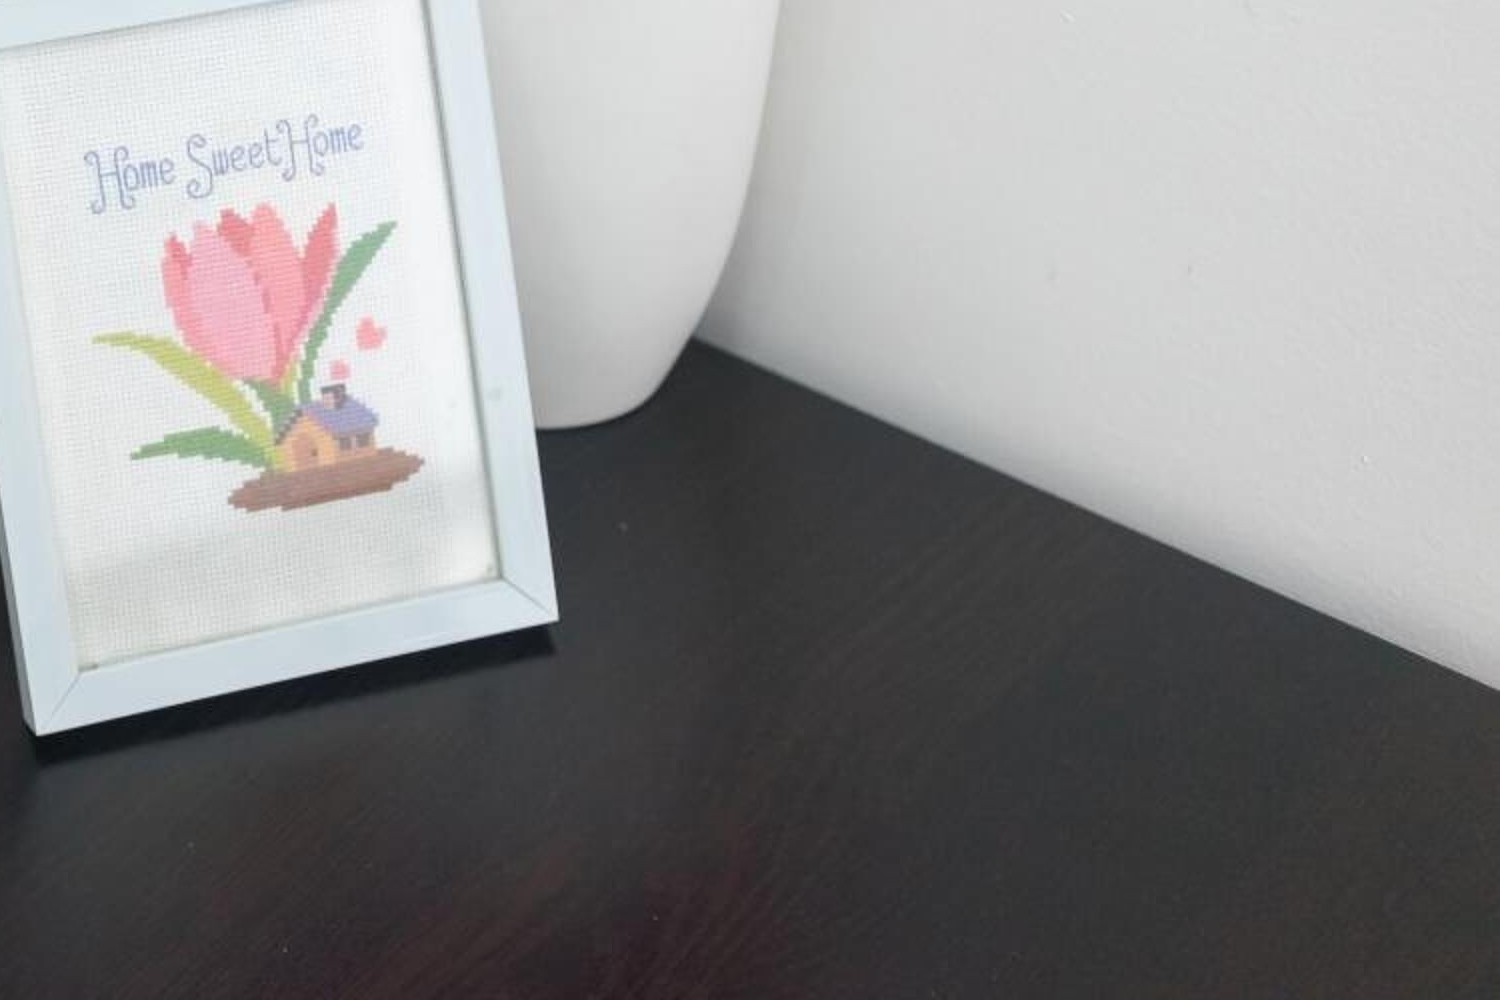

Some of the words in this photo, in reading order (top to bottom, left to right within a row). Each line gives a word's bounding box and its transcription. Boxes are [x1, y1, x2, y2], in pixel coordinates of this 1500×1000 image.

[84, 146, 176, 214] Home
[186, 129, 282, 199] Sweet
[276, 114, 363, 182] Home
